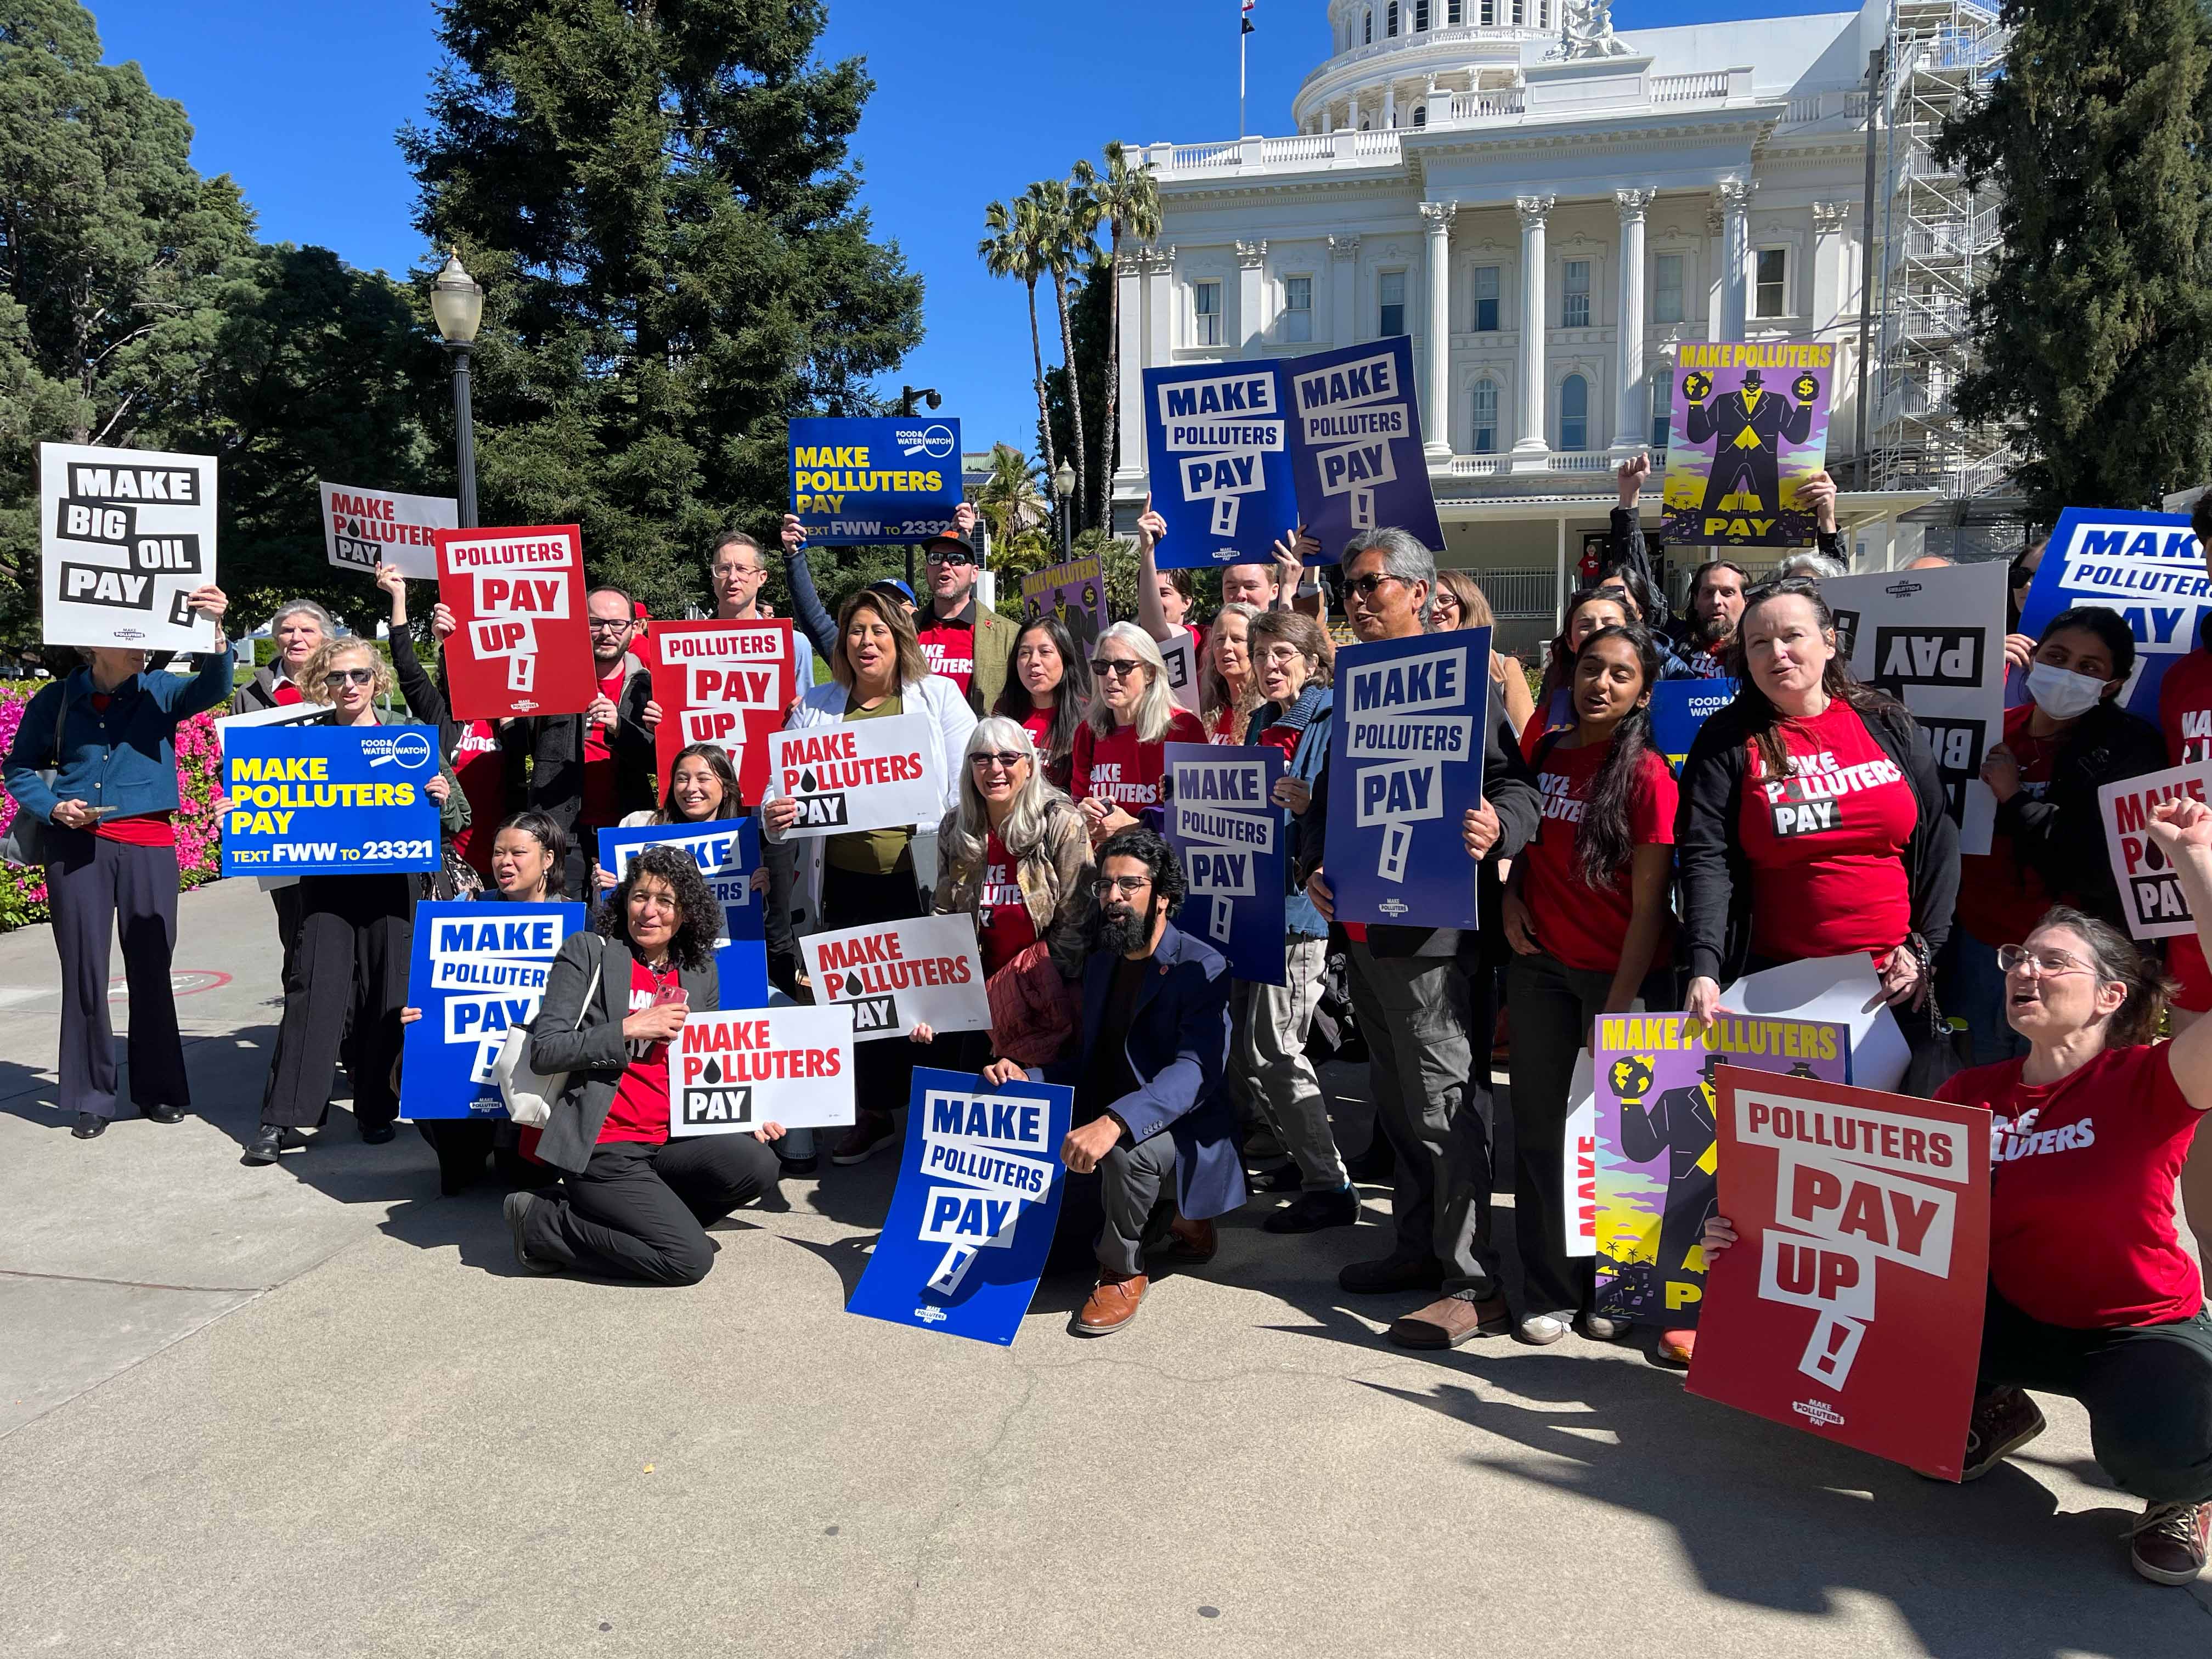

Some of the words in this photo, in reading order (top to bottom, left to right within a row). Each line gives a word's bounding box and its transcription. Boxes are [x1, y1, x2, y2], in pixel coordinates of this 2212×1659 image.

[1680, 345, 1731, 368] MAKE
[1734, 345, 1831, 368] POLLUTERS
[1167, 379, 1267, 417] MAKE
[1301, 361, 1390, 409] MAKE
[1174, 427, 1277, 444] POLLUTERS
[1310, 411, 1401, 437] POLLUTERS
[795, 447, 870, 467] MAKE
[1324, 444, 1383, 487] PAY
[76, 468, 192, 500] MAKE
[796, 471, 943, 491] POLLUTERS
[1188, 456, 1255, 493] PAY
[332, 492, 394, 521] MAKE
[797, 495, 845, 514] PAY
[1220, 502, 1233, 529] !
[1358, 494, 1368, 523] !
[67, 505, 126, 539] BIG
[333, 515, 448, 546] POLLUTER
[831, 521, 881, 535] FWW
[884, 527, 900, 535] TO
[1704, 518, 1776, 535] PAY
[138, 540, 192, 568] OIL
[339, 540, 377, 565] PAY
[454, 542, 563, 566] POLLUTERS
[2080, 531, 2207, 558] MAK
[67, 568, 148, 603] PAY
[1024, 572, 1045, 597] MAKE
[1045, 557, 1099, 590] POLLUTERS
[2073, 565, 2212, 598] POLLUTER
[483, 579, 560, 611] PAY
[478, 622, 525, 652] UP
[2123, 607, 2185, 643] AY
[669, 635, 776, 657] POLLUTERS
[1884, 636, 1974, 678] PAY
[517, 659, 528, 685] !
[696, 670, 771, 703] PAY
[1353, 658, 1457, 712] MAKE
[690, 713, 735, 741] UP
[1355, 725, 1462, 752] POLLUTERS
[782, 732, 857, 767] MAKE
[1921, 726, 1973, 769] BI
[232, 758, 329, 781] MAKE
[1178, 769, 1259, 800] MAKE
[232, 783, 415, 808] POLLUTERS
[1364, 766, 1434, 816] PAY
[232, 811, 295, 834] PAY
[793, 797, 840, 825] PAY
[1775, 802, 1833, 834] PAY
[1182, 810, 1267, 845] POLLUTERS
[232, 850, 269, 862] TEXT
[273, 843, 337, 861] FWW
[340, 849, 360, 860] TO
[363, 840, 433, 860] 23321
[1387, 831, 1404, 872] !
[1192, 855, 1246, 887] PAY
[1217, 901, 1227, 934] !
[441, 922, 553, 952] MAKE
[818, 932, 903, 972] MAKE
[442, 962, 550, 988] POLLUTER
[454, 999, 531, 1034] PAY
[853, 1000, 889, 1028] AY
[682, 1020, 770, 1054] MAKE
[1602, 1019, 1679, 1051] MAKE
[1684, 1018, 1837, 1060] POLLUTERS
[482, 1047, 499, 1077] !
[689, 1091, 746, 1120] PAY
[932, 1099, 1040, 1142] MAKE
[1749, 1102, 1953, 1168] POLLUTERS
[930, 1146, 1043, 1193] POLLUTERS
[930, 1197, 1012, 1238] PAY
[1792, 1163, 1939, 1257] PAY
[940, 1251, 967, 1286] !
[1776, 1242, 1859, 1300] UP
[917, 1311, 944, 1319] POLLUTERS
[1817, 1321, 1851, 1375] !
[1797, 1404, 1841, 1423] POLLUTERS
[1809, 1398, 1832, 1411] MAKE
[1810, 1417, 1825, 1426] PAY
